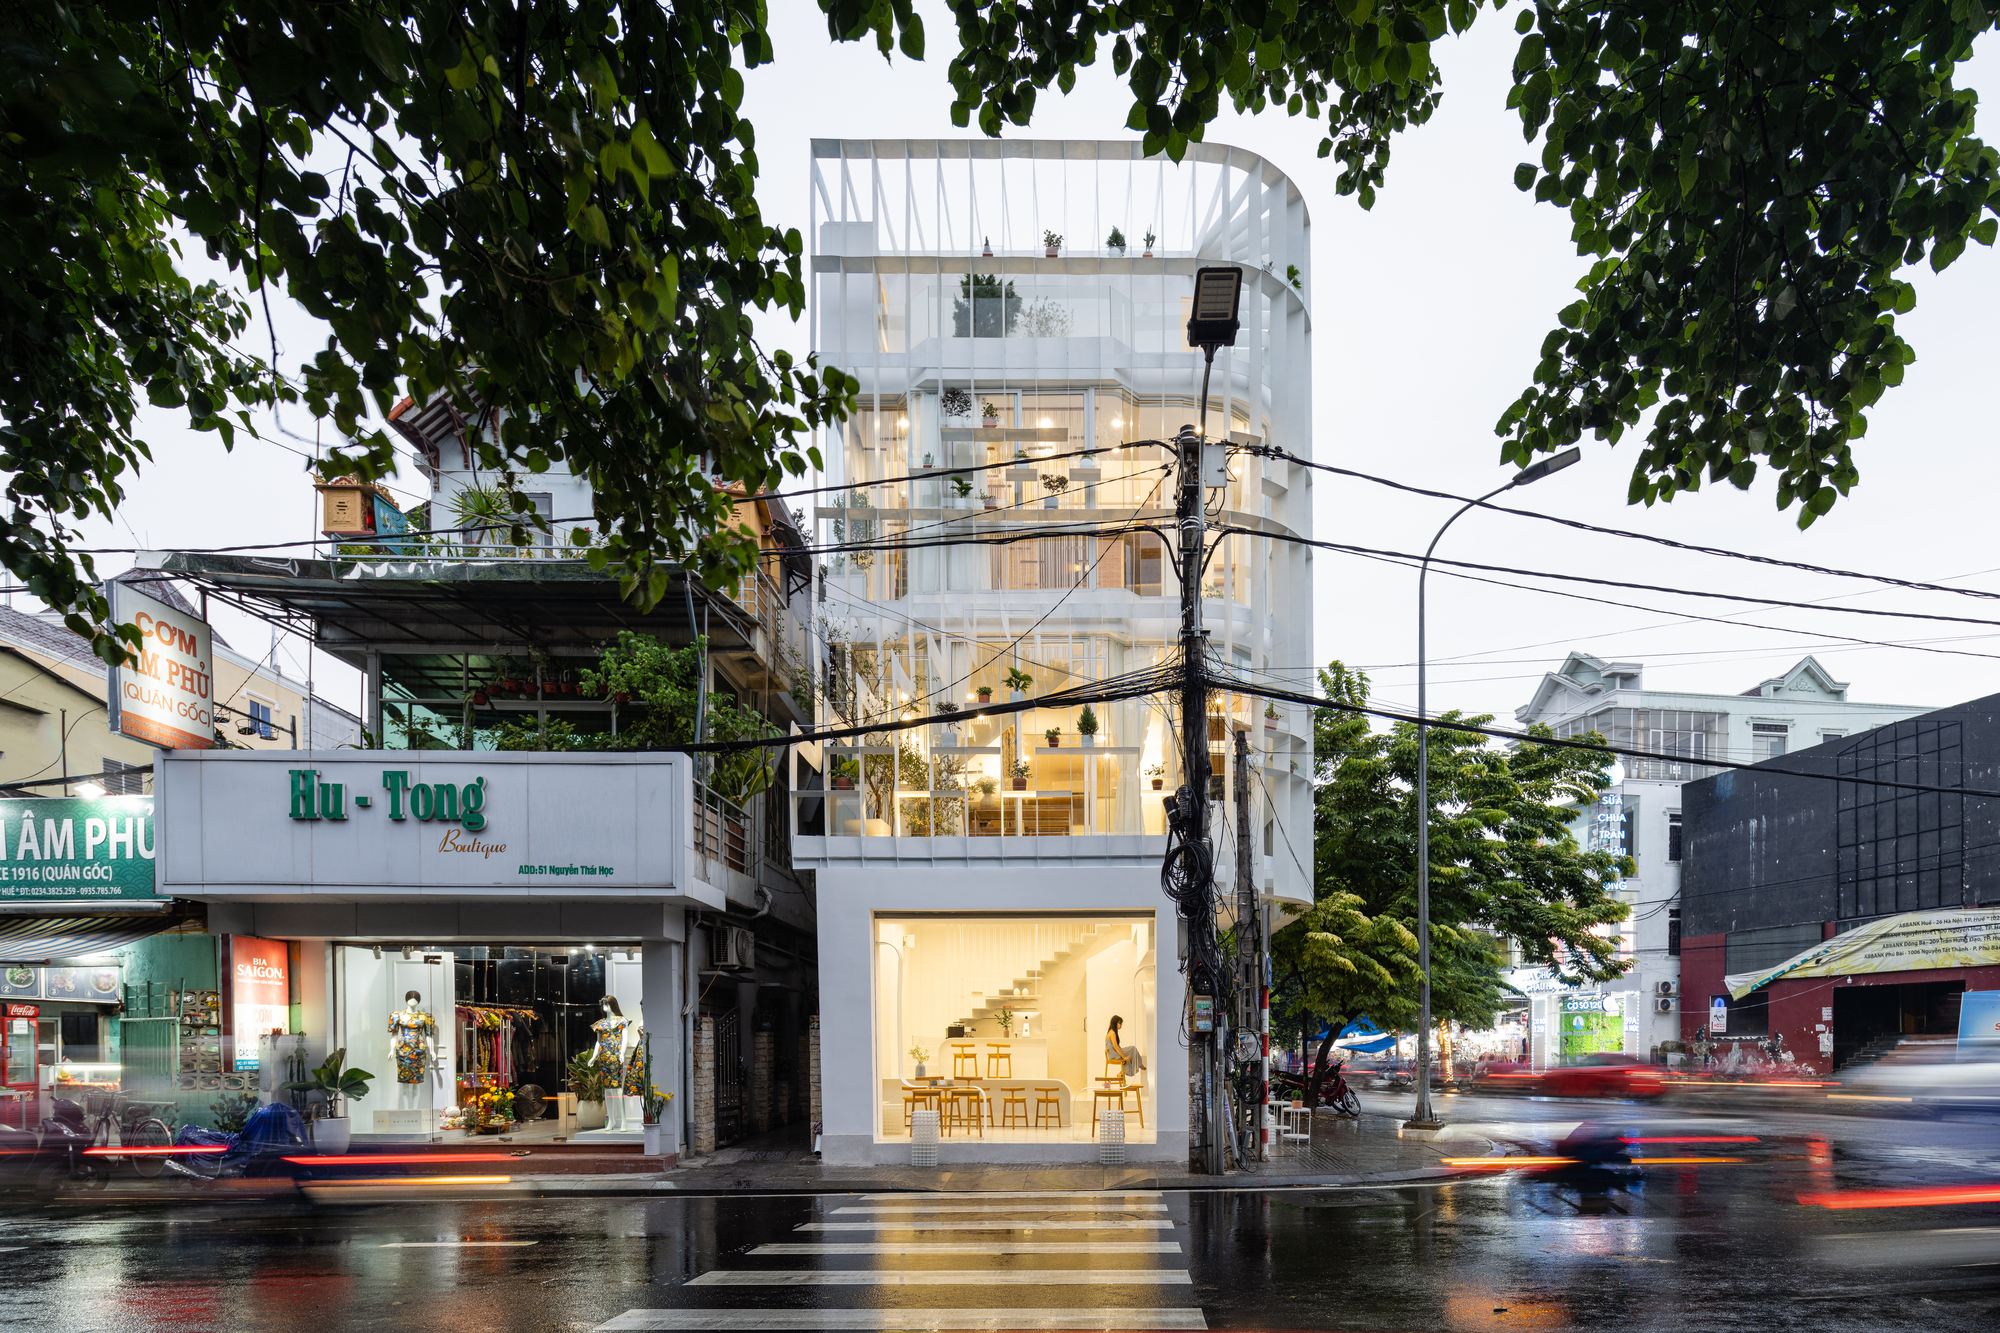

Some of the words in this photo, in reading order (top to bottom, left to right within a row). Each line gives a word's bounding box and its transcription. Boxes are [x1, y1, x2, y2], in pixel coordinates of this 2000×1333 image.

[135, 612, 197, 658] CƠM
[166, 661, 210, 699] PHỦ
[123, 681, 173, 713] (QUÁN
[177, 702, 211, 728] GỐC)
[289, 769, 348, 820] Hu
[382, 770, 488, 832] Tong
[16, 809, 76, 861] ÂM
[85, 803, 156, 860] PHỦ
[1598, 813, 1627, 822] CHUA
[439, 829, 507, 859] Boutique
[1600, 828, 1626, 839] TRÂN
[11, 866, 40, 881] 1916
[41, 863, 80, 881] (QUÁN
[82, 861, 113, 881] GỐC)
[549, 863, 579, 876] Nguyễn
[580, 864, 597, 876] Thái
[599, 865, 614, 877] Học
[252, 957, 267, 966] BIA
